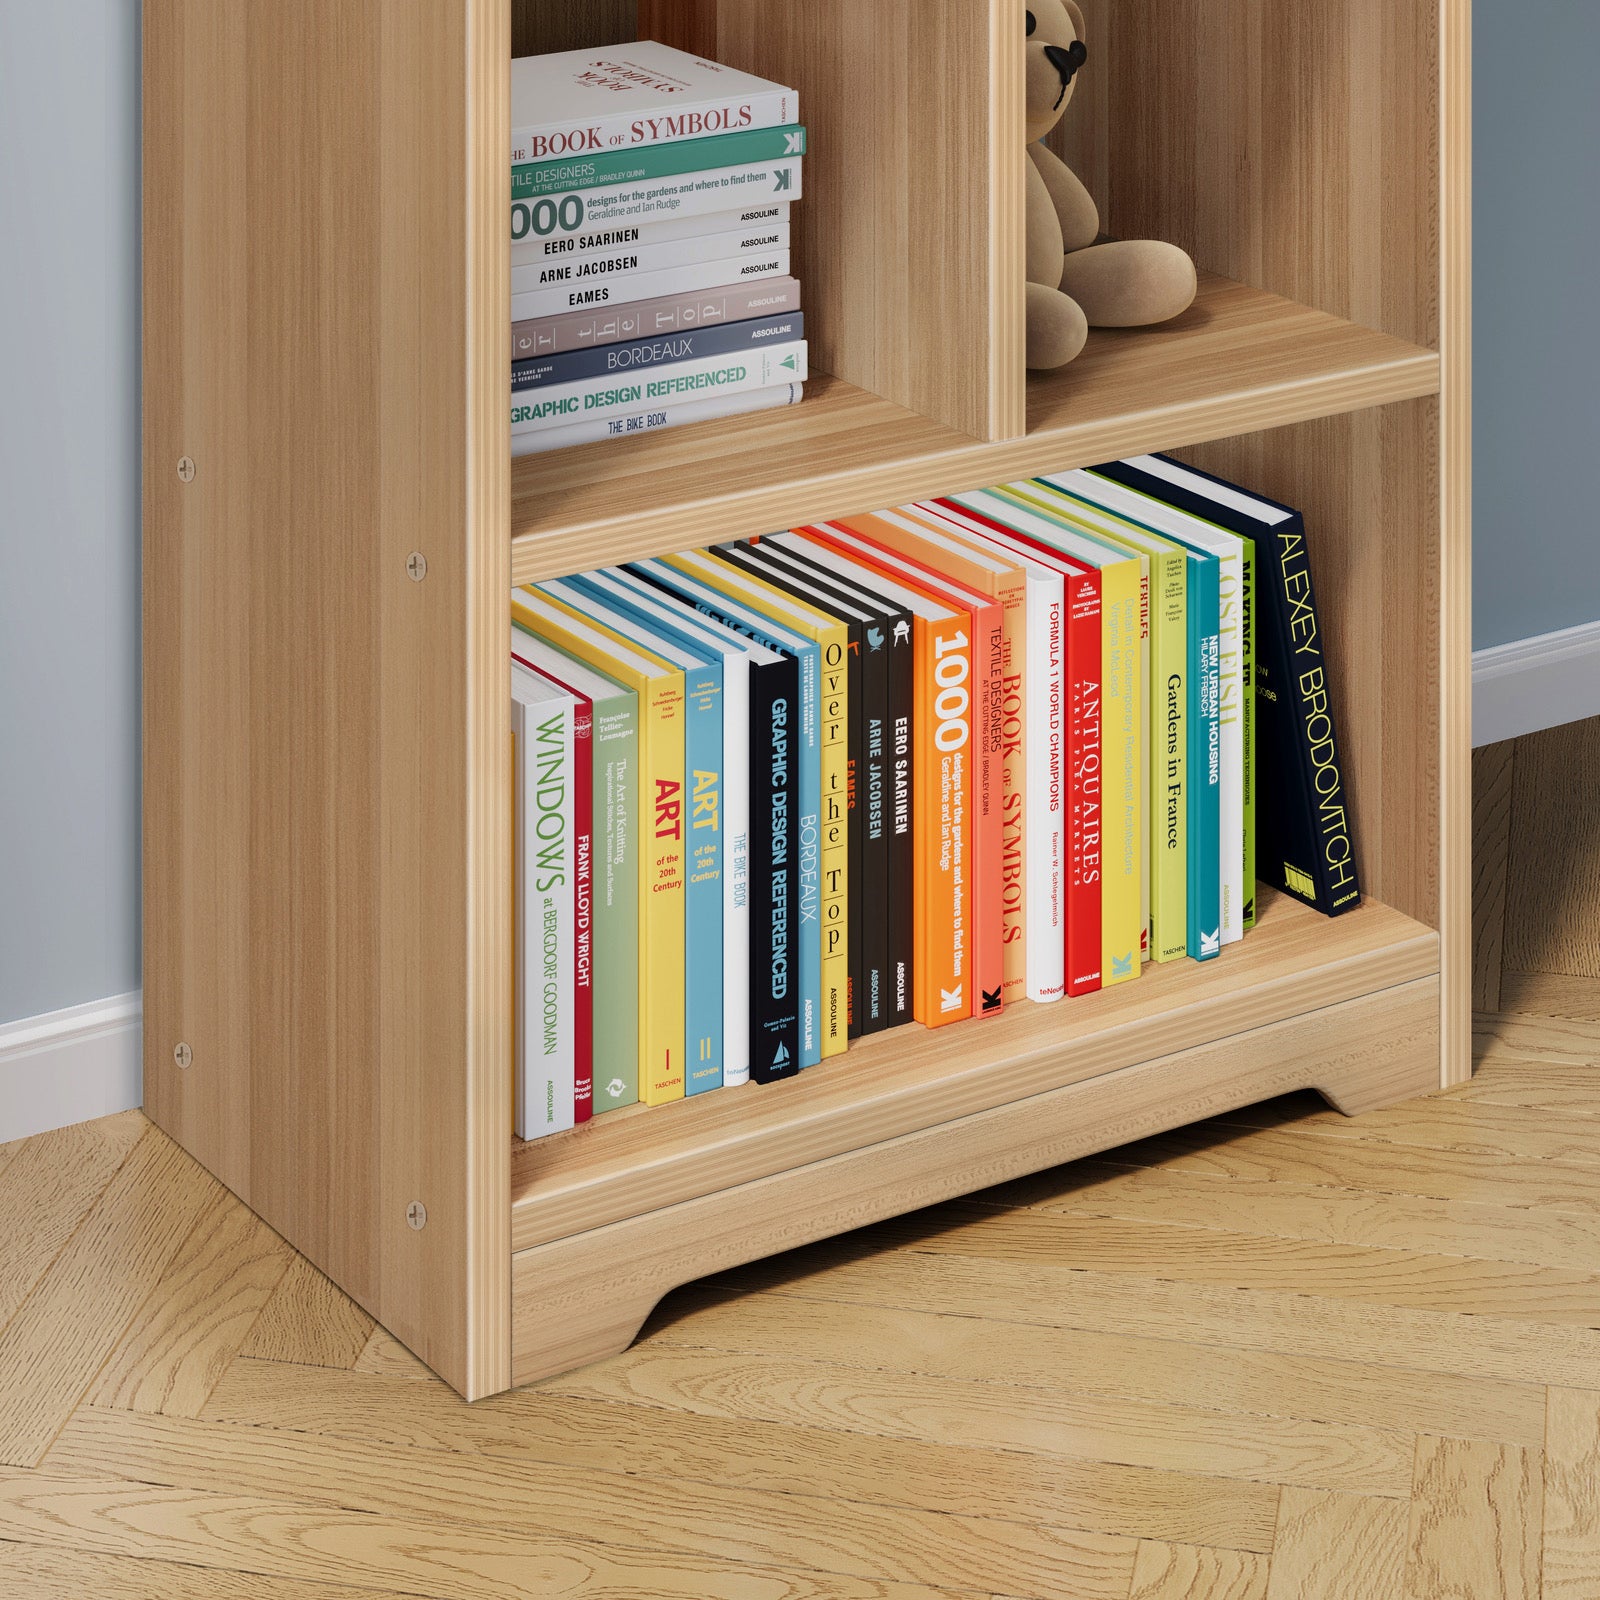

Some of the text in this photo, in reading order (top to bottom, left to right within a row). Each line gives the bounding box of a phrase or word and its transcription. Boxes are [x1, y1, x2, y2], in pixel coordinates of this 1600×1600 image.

[531, 104, 752, 157] BOOK OF SYMBOLS
[536, 163, 595, 183] DESIGNERS
[542, 183, 553, 191] THE
[554, 180, 579, 189] CUTTING
[580, 177, 594, 186] EDGE
[600, 173, 626, 183] BRADLEY
[628, 169, 646, 178] QUINN
[587, 172, 767, 208] designs for the gardens and where to find them
[544, 209, 779, 255] EERO SAARINEN ASSOULINE
[588, 199, 681, 221] Geraldine and Ian Rudge
[540, 235, 779, 283] ARNE JACOBSEN ASSOULINE
[569, 262, 779, 306] EAMES ASSOULINE
[747, 295, 788, 308] ASSOULINE
[607, 324, 792, 369] BORDEAUX ASSOULINE
[511, 396, 579, 424] GRAPHIC
[584, 385, 642, 411] DESIGN
[646, 366, 747, 392] REFERENCED
[608, 412, 667, 434] THE BIKE BOOK
[1003, 637, 1011, 669] THE
[1049, 602, 1059, 668] FORMULA
[1108, 602, 1121, 698] Virginia McLeod
[825, 643, 843, 741] Over
[982, 679, 989, 688] AT
[991, 626, 1002, 753] TEXTILE DESIGNERS
[1049, 680, 1059, 730] WORLD
[1201, 637, 1209, 717] HILARY FRENCH
[1003, 672, 1021, 760] BOOK
[1121, 598, 1136, 876] Detail in Contemporary Residential Architecture
[1208, 634, 1218, 785] NEW URBAN HOUSING
[1277, 533, 1320, 655] ALEXEY
[1299, 666, 1355, 890] BRODOVITCH
[1049, 735, 1059, 812] CHAMPIONS
[1083, 680, 1100, 885] ANTIQUAIRES
[1167, 674, 1182, 849] Gardens in France
[614, 758, 627, 865] The Art of Knitting
[655, 779, 681, 841] ART
[693, 769, 719, 832] ART
[828, 772, 840, 843] the
[934, 630, 969, 976] 1000 designs for the gardens and where to find them
[940, 756, 951, 871] Geraldine and Ian Rudge
[656, 854, 679, 865] of the
[659, 867, 677, 878] 20th
[690, 869, 720, 883] Century
[694, 844, 716, 857] of the
[696, 857, 714, 869] 20th
[733, 832, 746, 909] THE BIKE BOOK
[771, 698, 788, 1000] GRAPHIC DESIGN REFERENCED
[869, 718, 882, 1019] ARNE JACOBSEN ASSOULINE
[895, 717, 908, 1012] EERO SAARINEN ASSOULINE
[1003, 792, 1022, 944] SYMBOLS
[536, 710, 565, 1056] WINDOWS at BERGDORF GOODMAN
[577, 834, 590, 987] FRANK LLOYD WRIGHT
[653, 879, 682, 893] Century
[826, 869, 842, 954] Top
[800, 814, 817, 1051] BORDEAUX ASSOULINE
[1162, 945, 1186, 956] TASCHEN
[692, 1067, 719, 1080] TASCHEN
[700, 1037, 711, 1061] II
[655, 1077, 681, 1090] TASCHEN
